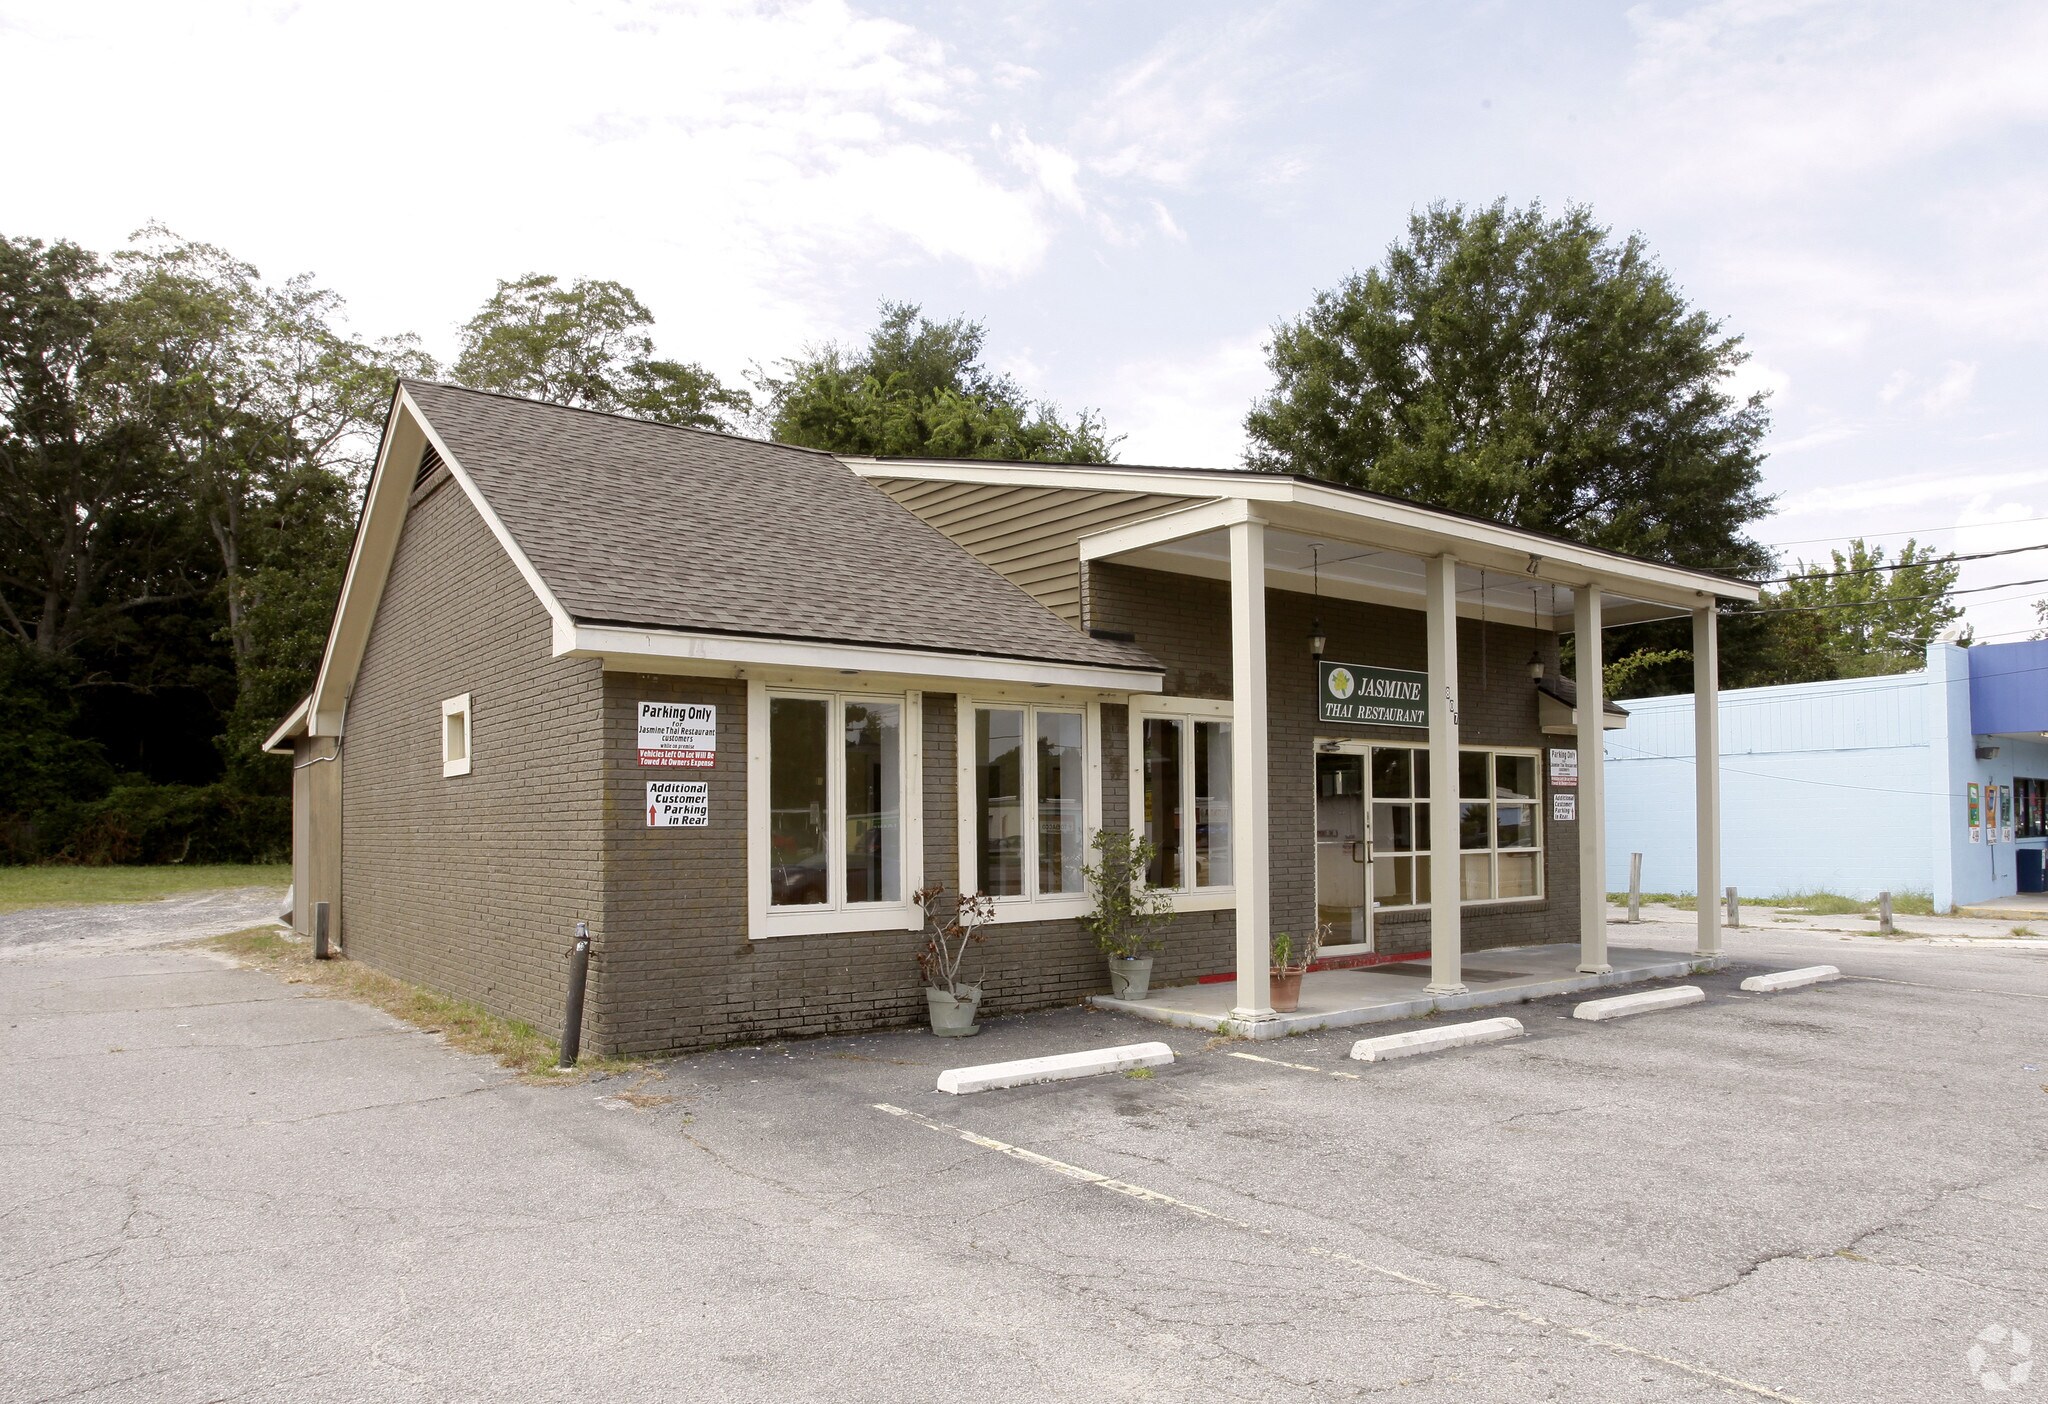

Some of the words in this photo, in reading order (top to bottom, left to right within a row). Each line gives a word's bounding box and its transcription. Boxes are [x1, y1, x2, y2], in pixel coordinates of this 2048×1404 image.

[1358, 678, 1421, 700] JASMINE
[642, 704, 686, 721] Parking
[688, 706, 712, 722] Only
[1325, 702, 1353, 718] THAI
[1357, 706, 1424, 722] RESTAURANT
[639, 726, 665, 734] Jasmine
[681, 728, 715, 736] Restaurant
[640, 750, 664, 758] Vehicles
[1552, 750, 1567, 760] Parking
[1567, 751, 1575, 760] Only
[650, 783, 706, 792] Additional
[655, 794, 706, 803] Customer
[664, 805, 707, 815] Parking
[669, 816, 679, 825] in
[682, 816, 706, 825] Rear
